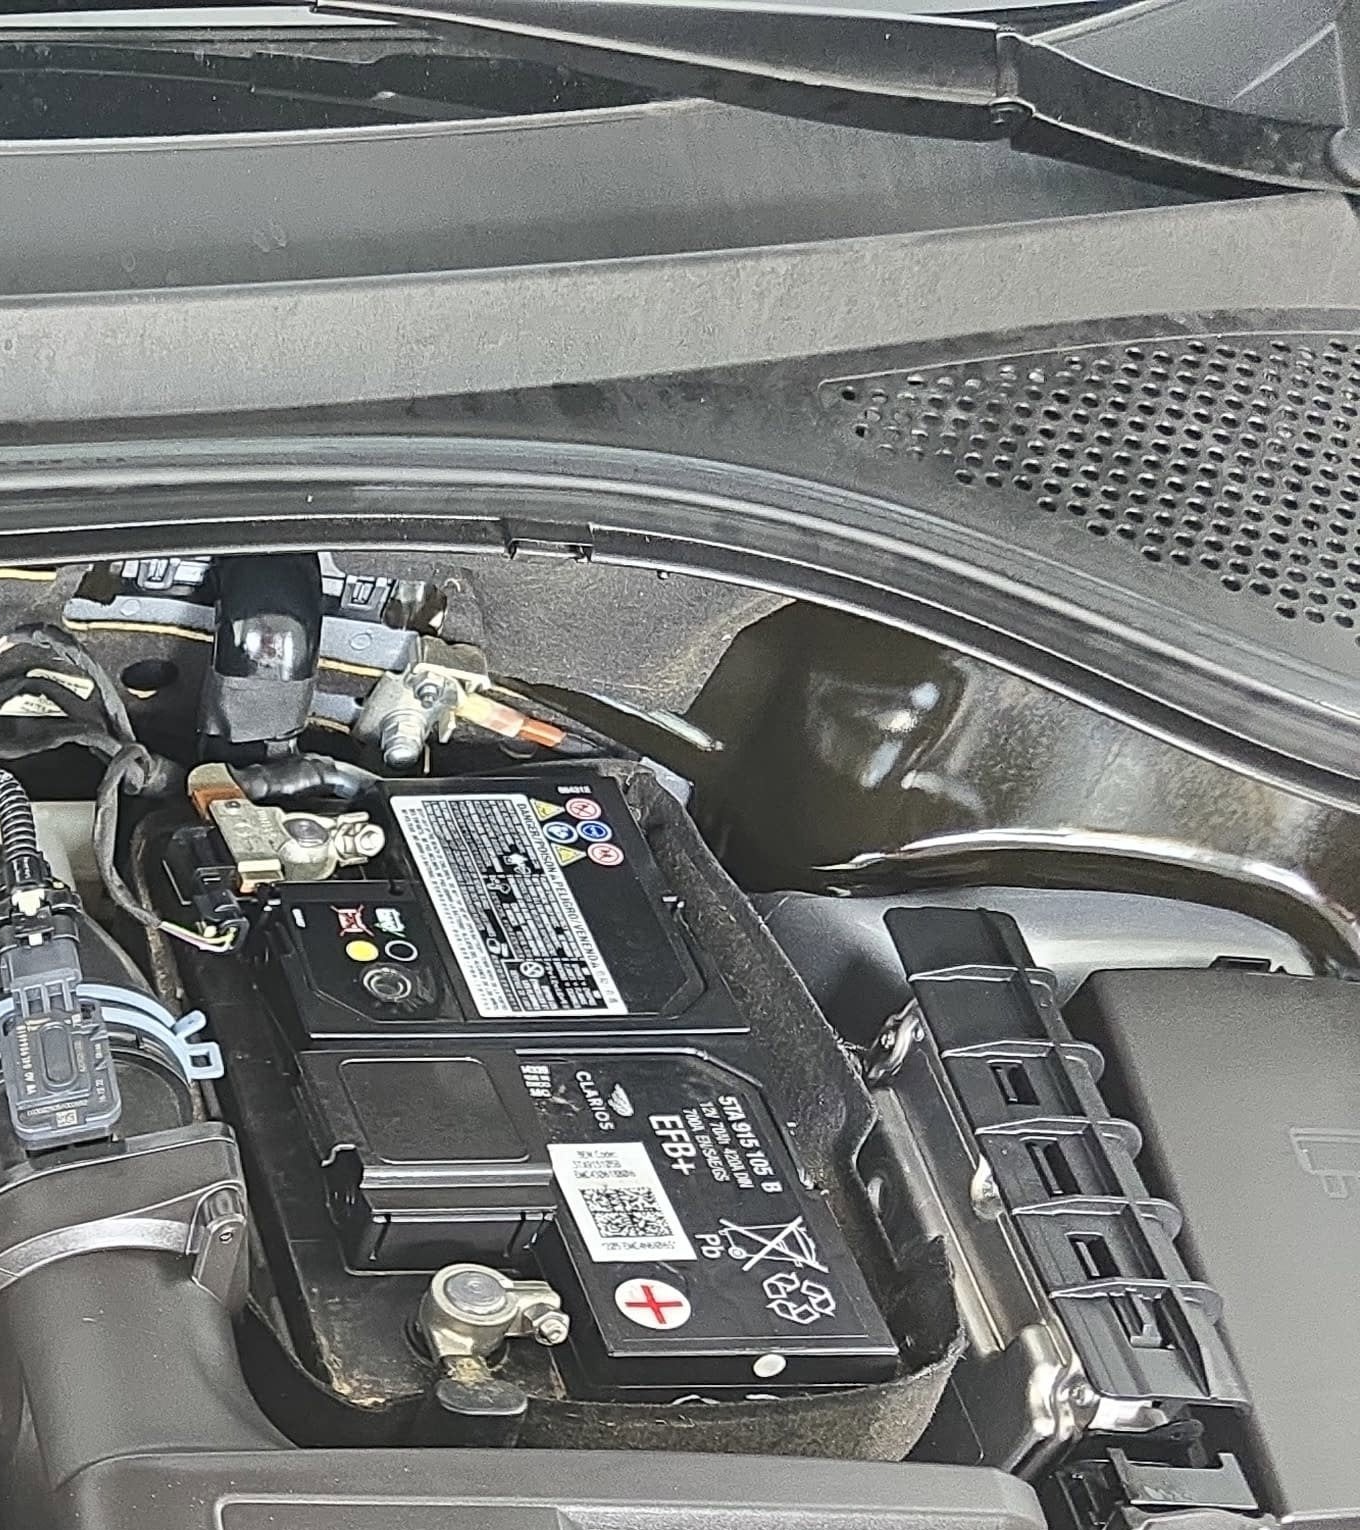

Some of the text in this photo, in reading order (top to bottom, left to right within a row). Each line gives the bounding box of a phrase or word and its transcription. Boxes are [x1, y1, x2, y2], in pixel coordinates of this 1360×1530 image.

[516, 803, 557, 873] DANGER/POISON
[576, 1070, 615, 1132] CLARIOS
[700, 1101, 720, 1118] 12V
[682, 1108, 705, 1132] 700A
[648, 1115, 697, 1175] EFB+
[718, 1095, 783, 1193] 5TA 915 105 B
[723, 1147, 746, 1171] 420A
[733, 1172, 755, 1188] DIN
[694, 1233, 726, 1259] Pb
